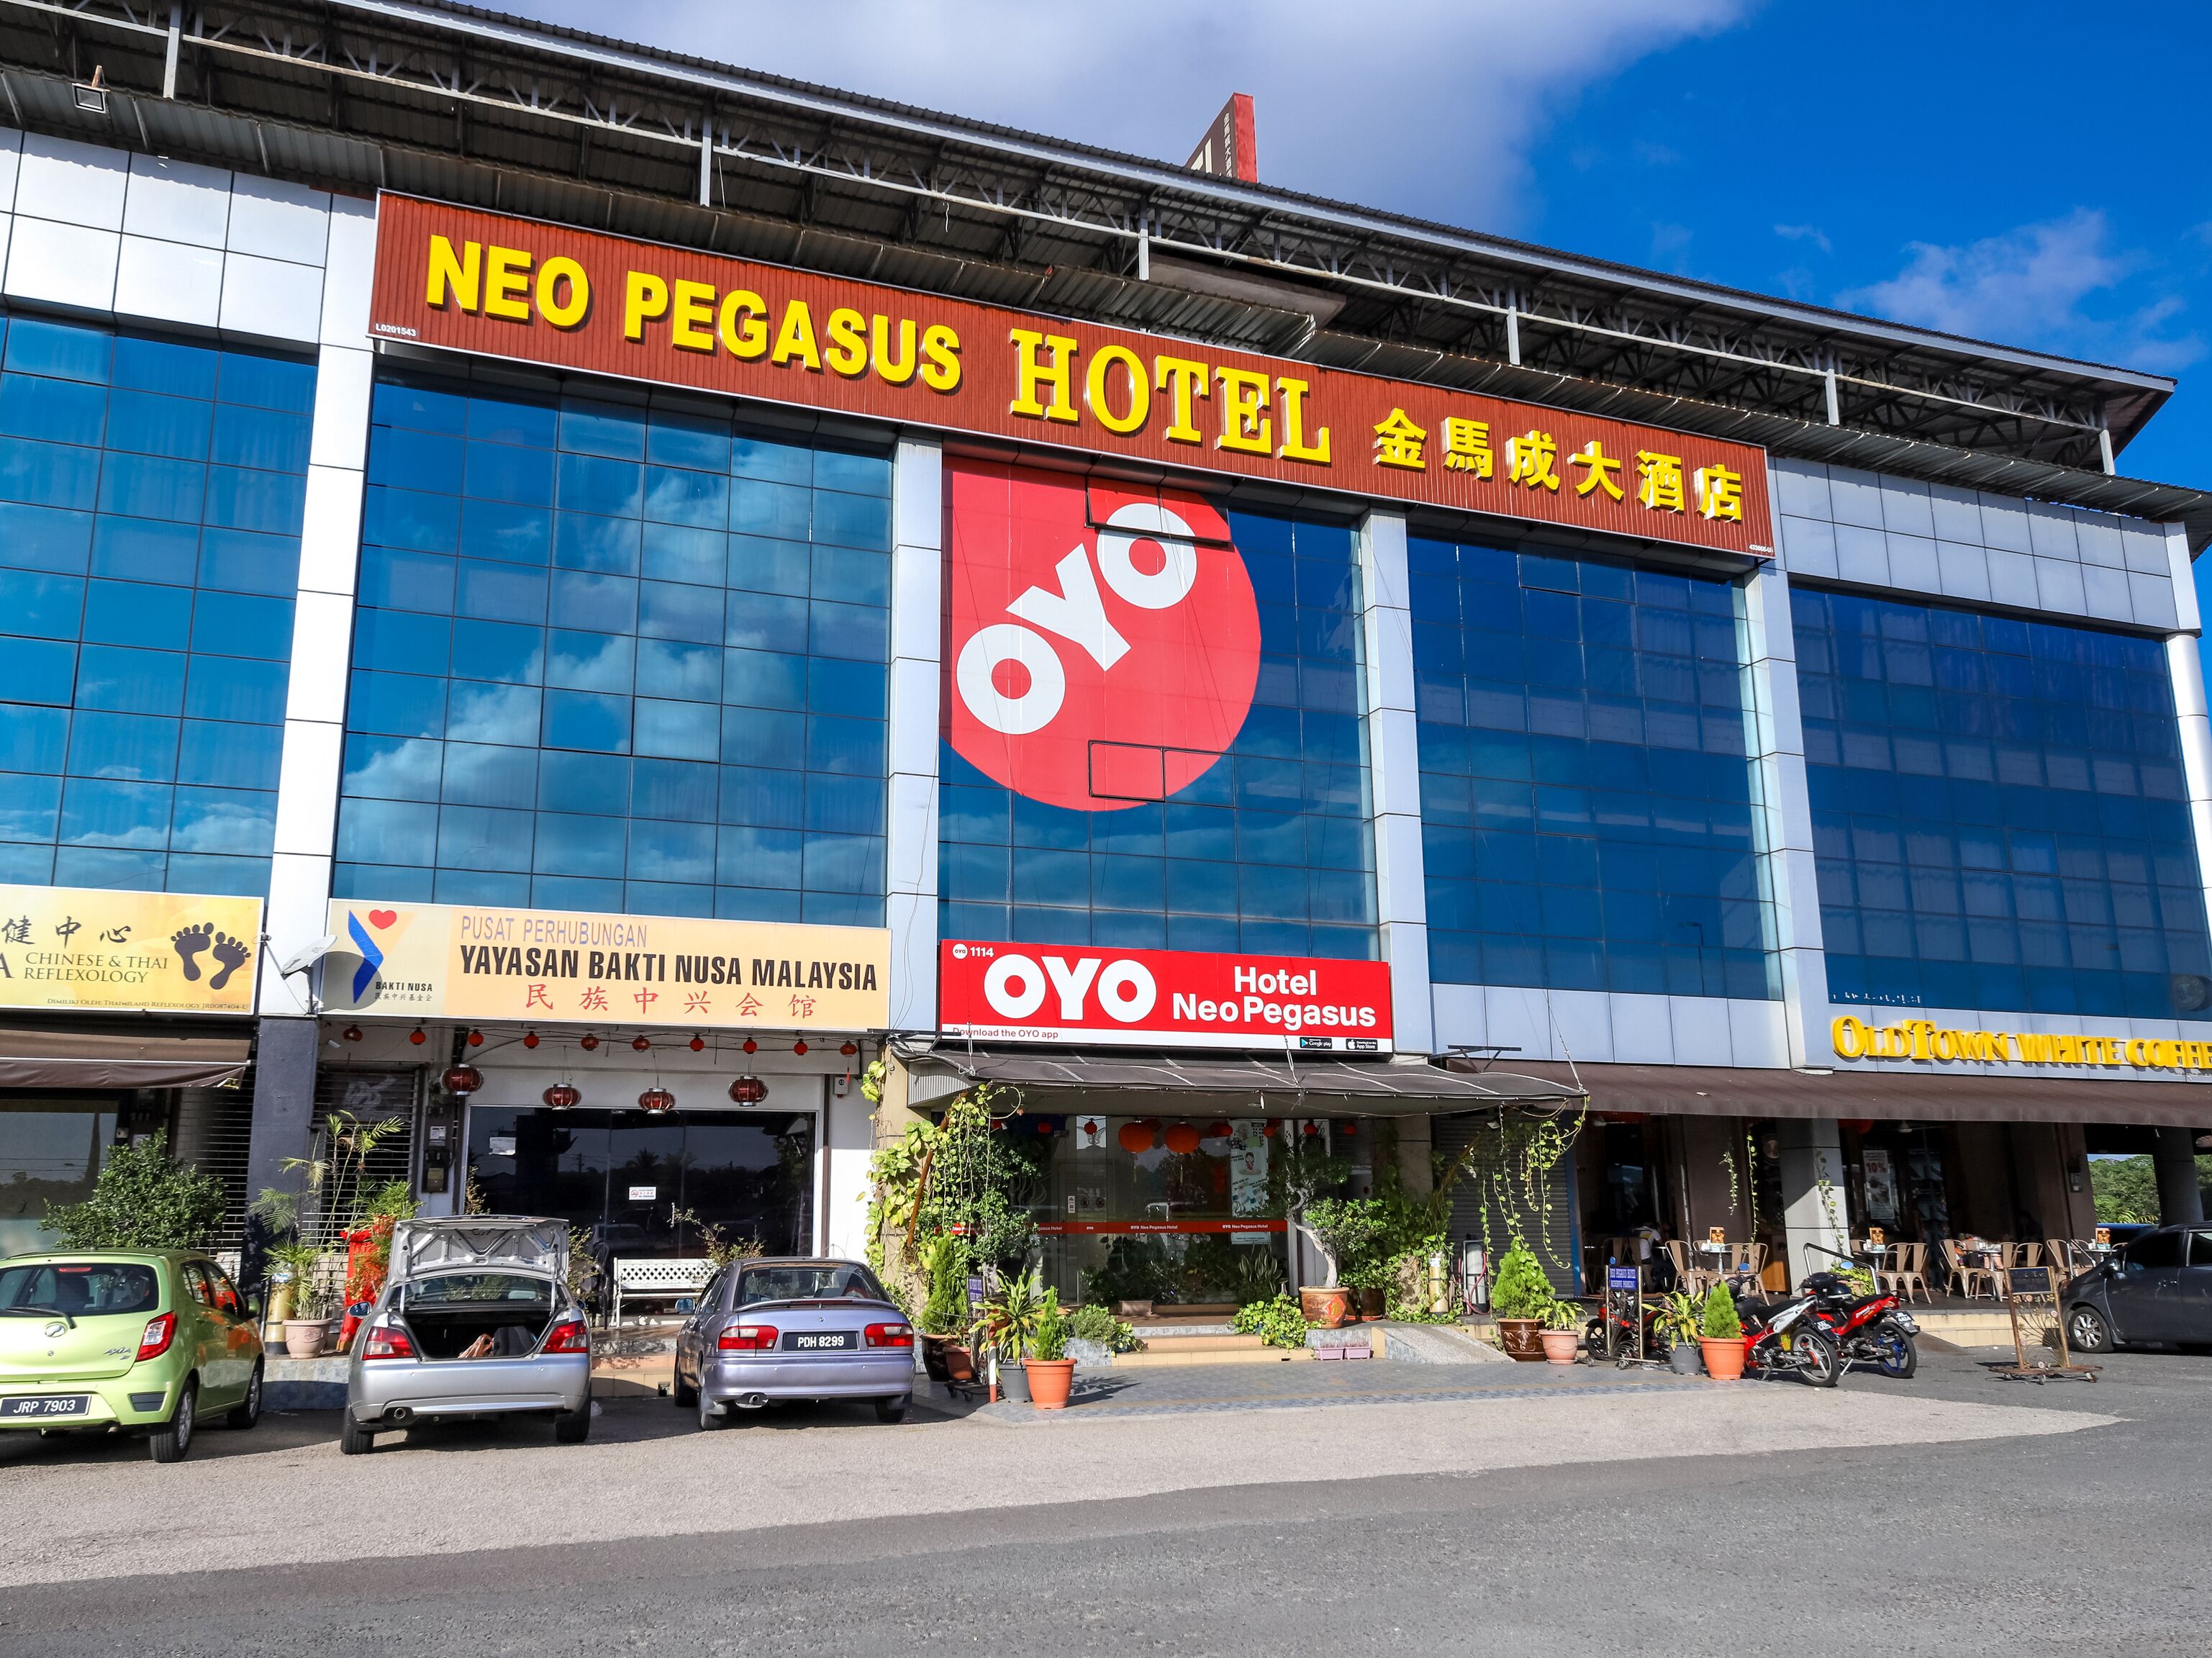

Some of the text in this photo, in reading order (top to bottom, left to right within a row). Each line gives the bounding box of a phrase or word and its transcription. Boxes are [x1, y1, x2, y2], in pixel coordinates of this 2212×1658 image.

[375, 323, 417, 337] L0201543
[425, 234, 1331, 465] NEO PEGASUS HOTEL
[1372, 407, 1743, 522] 金馬成大酒店
[956, 502, 1198, 735] OYO
[461, 915, 647, 948] PUSAT PERHUBUNGAN
[26, 952, 168, 969] CHINESE & THAI
[970, 946, 994, 958] 1114
[24, 967, 149, 983] REFLEXOLOGY
[460, 945, 877, 991] YAYASAN BAKTI NUSA MALAYSIA
[1234, 966, 1317, 996] Hotel
[376, 982, 432, 992] BAKTI NUSA
[525, 984, 818, 1019] 民族中兴会馆
[984, 953, 1157, 1023] OYO
[1172, 993, 1377, 1031] Neo Pegasus
[953, 1028, 1001, 1037] Download
[1002, 1028, 1017, 1037] the
[1041, 1030, 1059, 1039] app
[2015, 1033, 2123, 1066] WHITE
[1867, 1162, 1887, 1173] 10%
[797, 1336, 845, 1348] PDH 8299
[13, 1400, 76, 1413] JRP 7903
